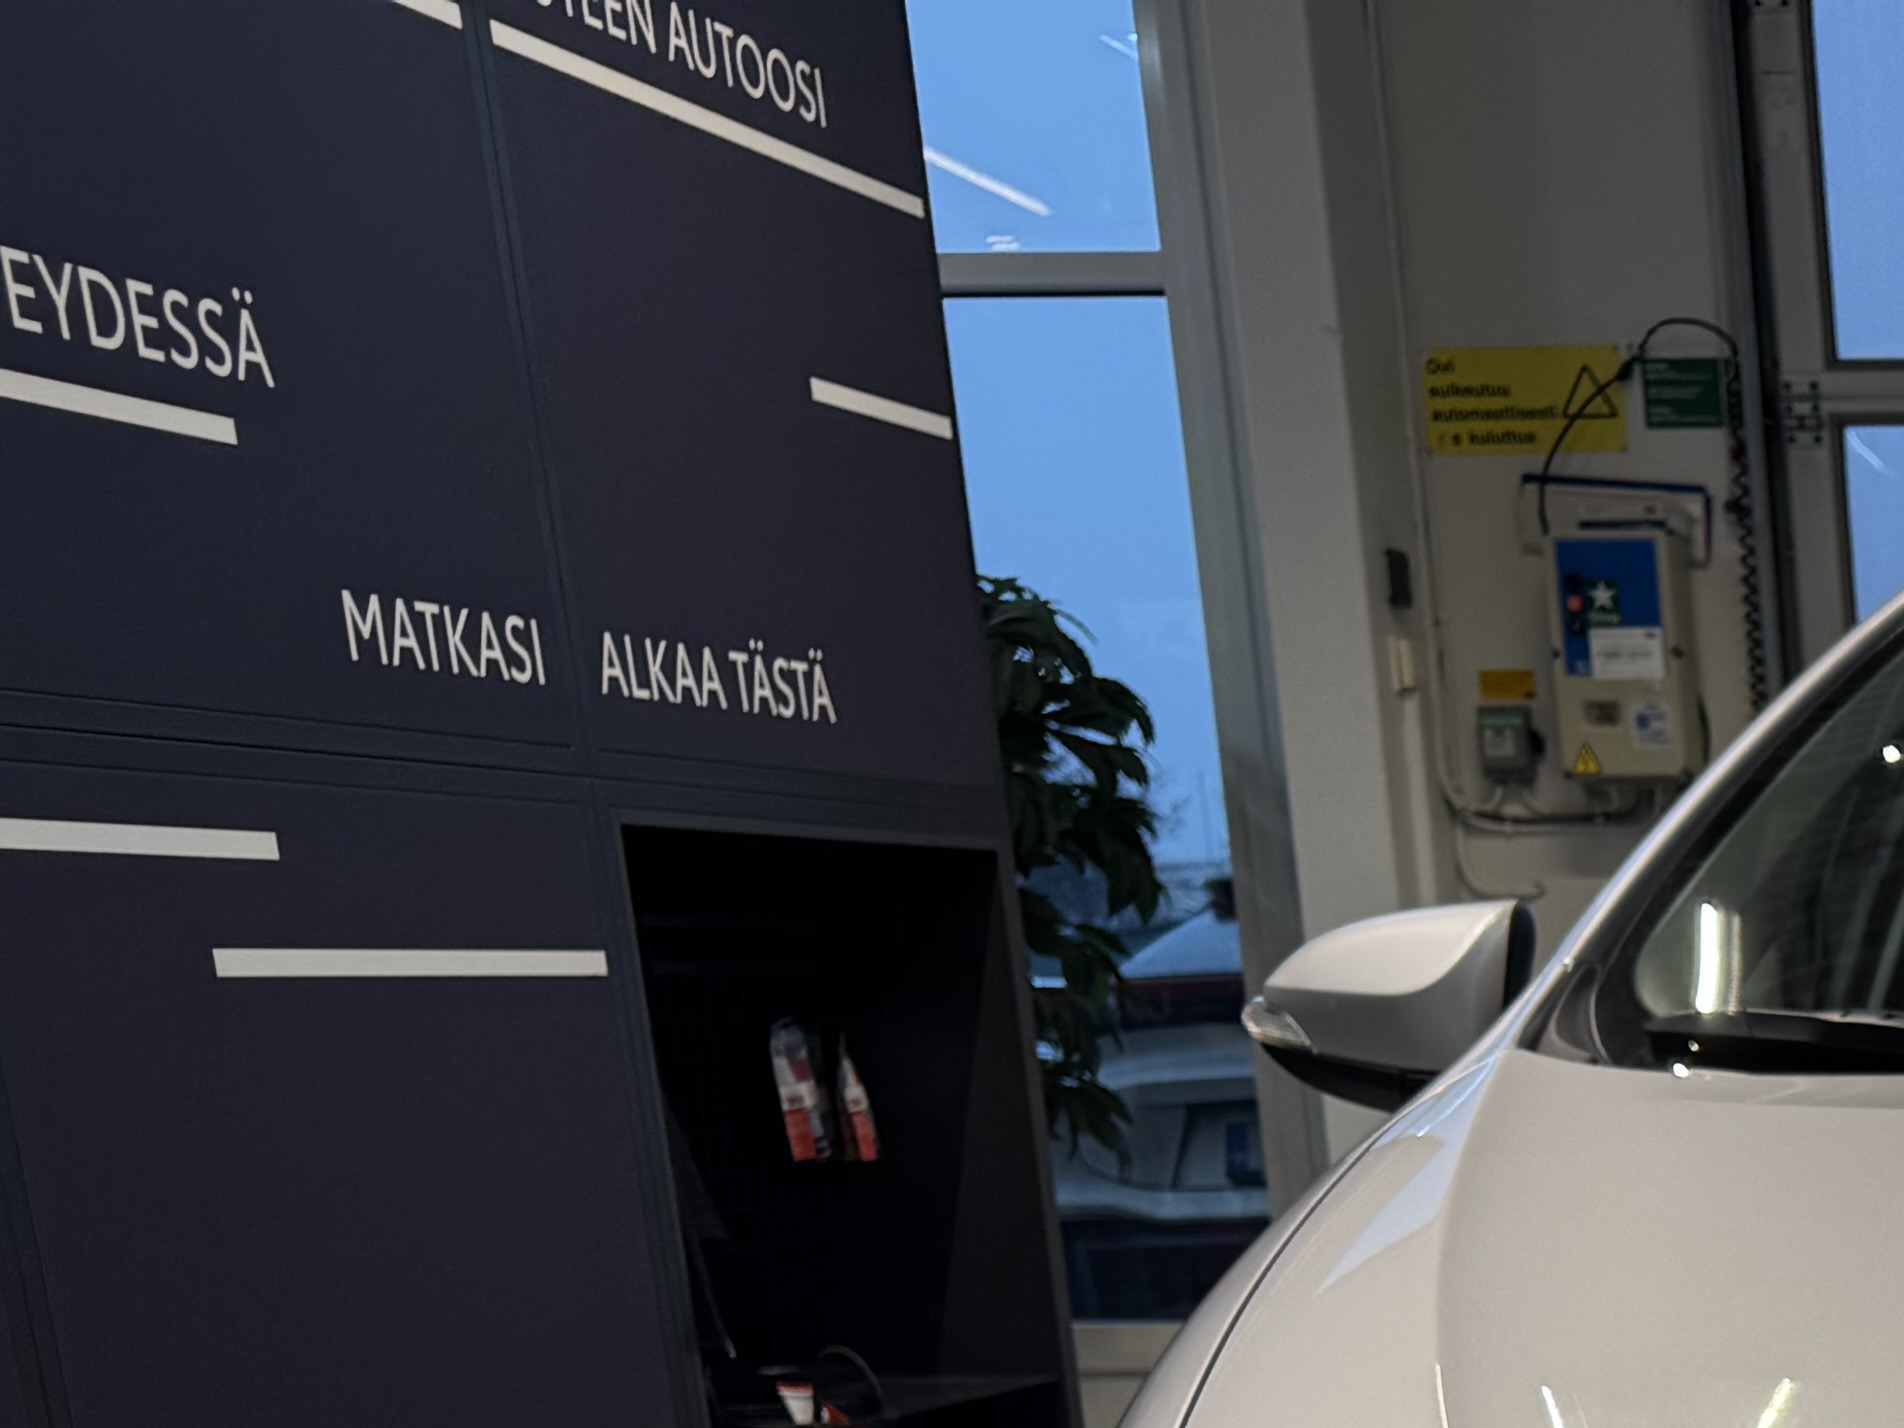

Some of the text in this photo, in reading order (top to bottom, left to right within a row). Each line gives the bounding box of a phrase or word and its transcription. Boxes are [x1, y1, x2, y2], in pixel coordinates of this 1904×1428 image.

[669, 1, 828, 128] AUTOOSI
[0, 245, 276, 388] EYDESSÄ
[341, 589, 838, 724] MATKASI ALKAA TÄSTÄ
